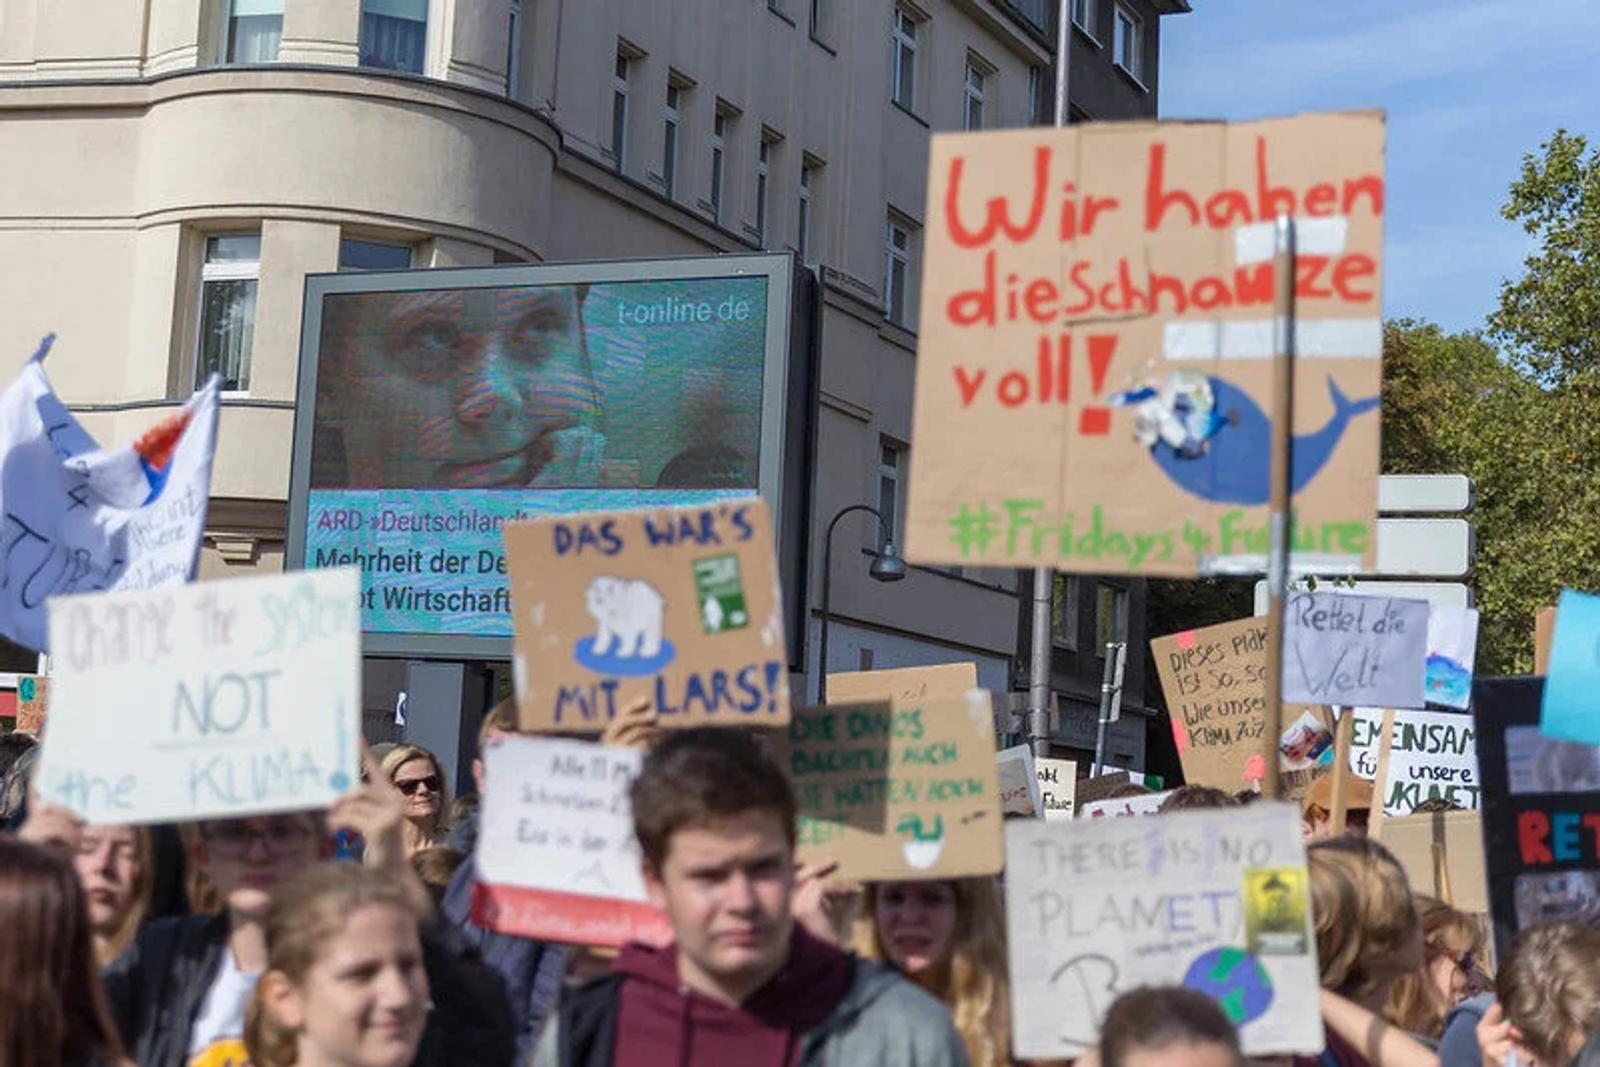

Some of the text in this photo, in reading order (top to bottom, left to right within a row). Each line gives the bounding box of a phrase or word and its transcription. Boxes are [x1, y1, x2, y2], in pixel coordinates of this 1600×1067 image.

[945, 136, 1385, 249] Wir haben
[946, 250, 1376, 327] die Schnauze
[953, 333, 1119, 436] voll!
[553, 507, 754, 556] DAS WAR'S
[316, 547, 422, 574] Mehrheit
[430, 549, 469, 574] der
[1372, 599, 1406, 635] die
[553, 661, 782, 724] MIT LARS!
[1295, 641, 1380, 697] Welt
[171, 668, 283, 736] NOT
[1350, 717, 1476, 756] EMEINSAM
[1356, 750, 1473, 784] fü unsere
[1029, 836, 1275, 875] THERE IS NO
[1027, 888, 1240, 940] PLANET
